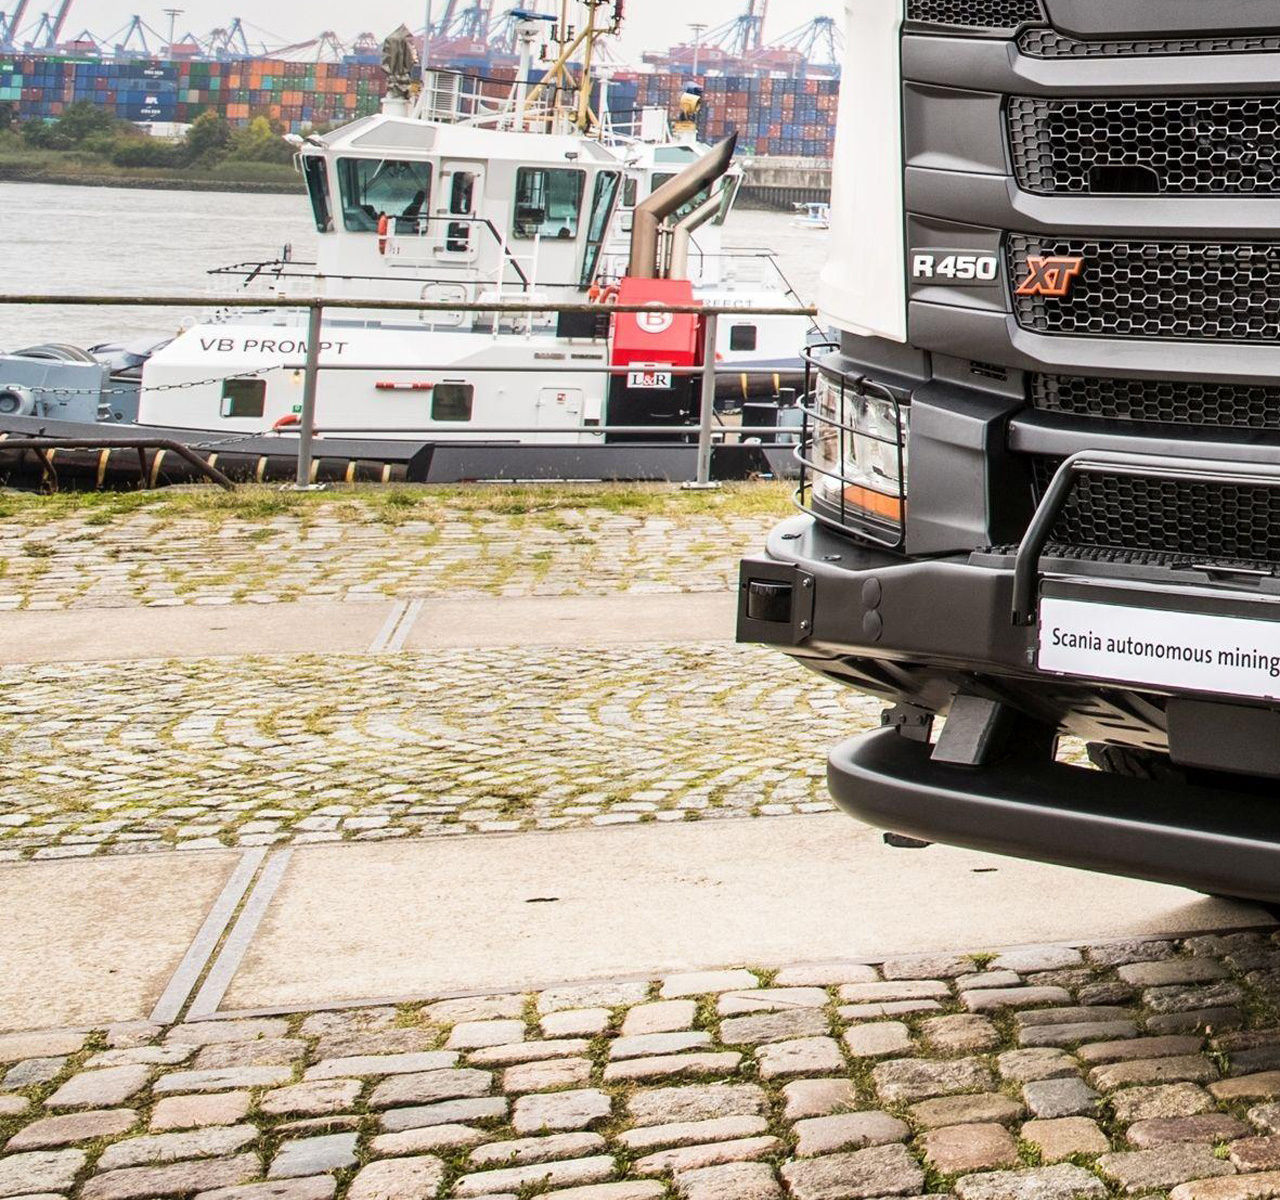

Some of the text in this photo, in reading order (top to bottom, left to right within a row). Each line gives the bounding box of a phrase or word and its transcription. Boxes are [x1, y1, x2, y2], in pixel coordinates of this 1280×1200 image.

[913, 255, 997, 280] R 450
[1016, 256, 1084, 297] XT
[200, 338, 234, 352] VB
[633, 373, 668, 385] L&R
[1052, 627, 1280, 677] Scania autonomous mining
